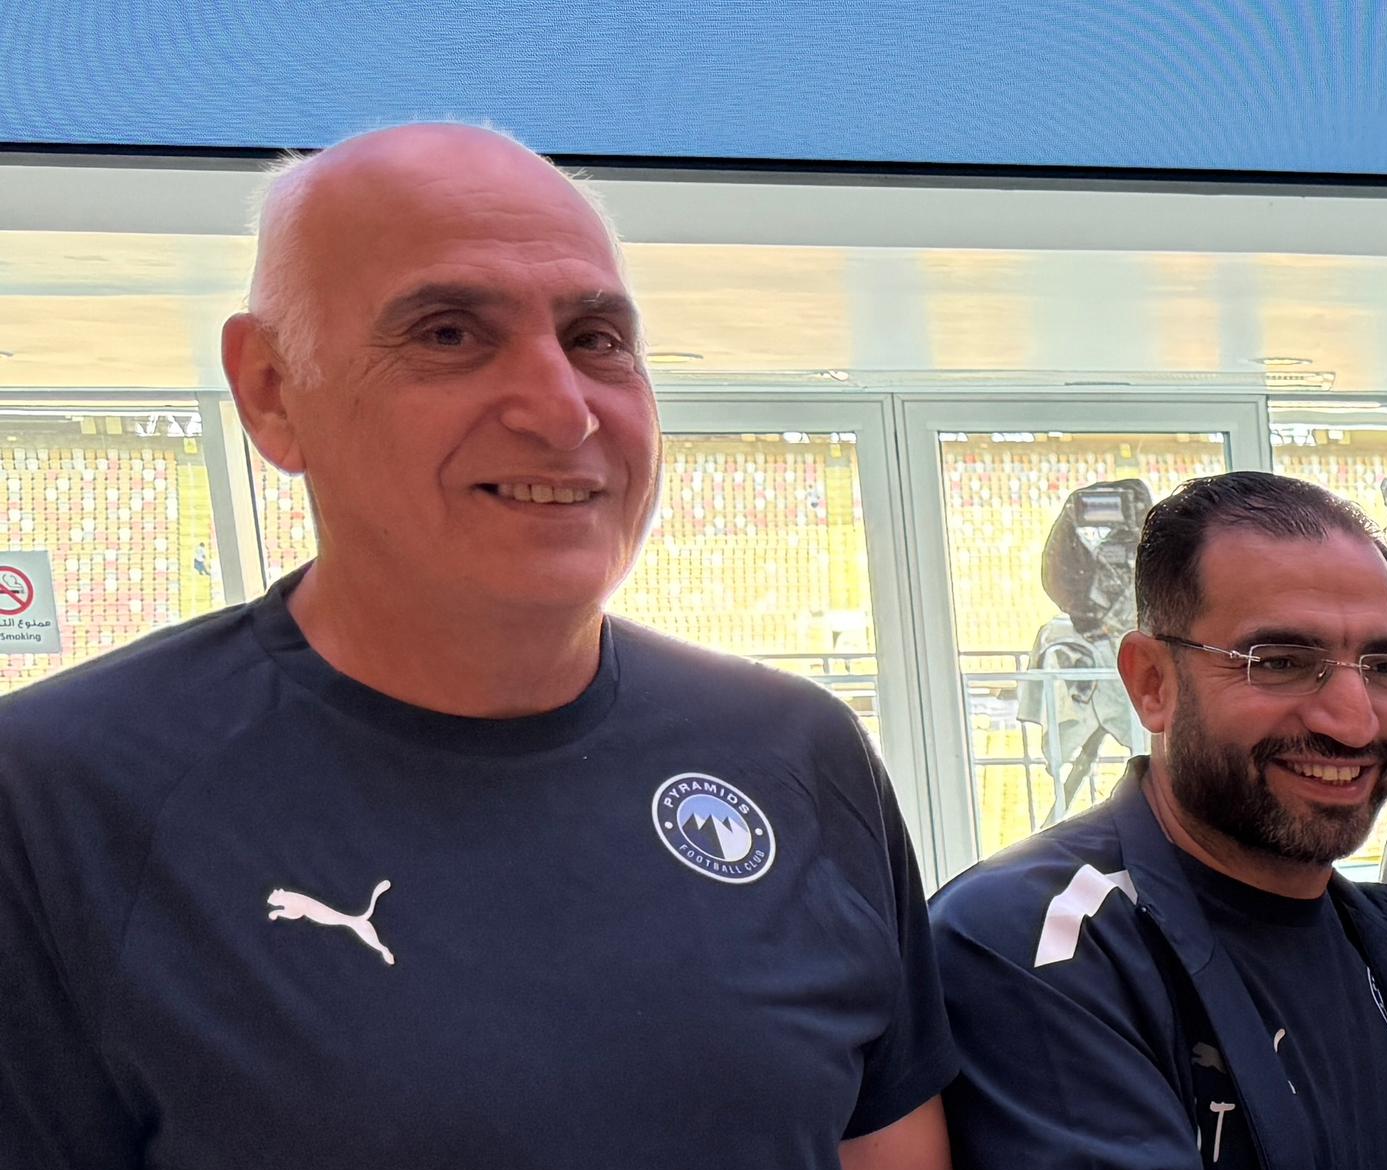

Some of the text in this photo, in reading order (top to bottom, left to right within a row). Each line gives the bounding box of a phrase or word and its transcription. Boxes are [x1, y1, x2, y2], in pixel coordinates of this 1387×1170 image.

[664, 781, 750, 815] PYRAMIDS
[679, 843, 766, 875] FOOTBALL CLUB
